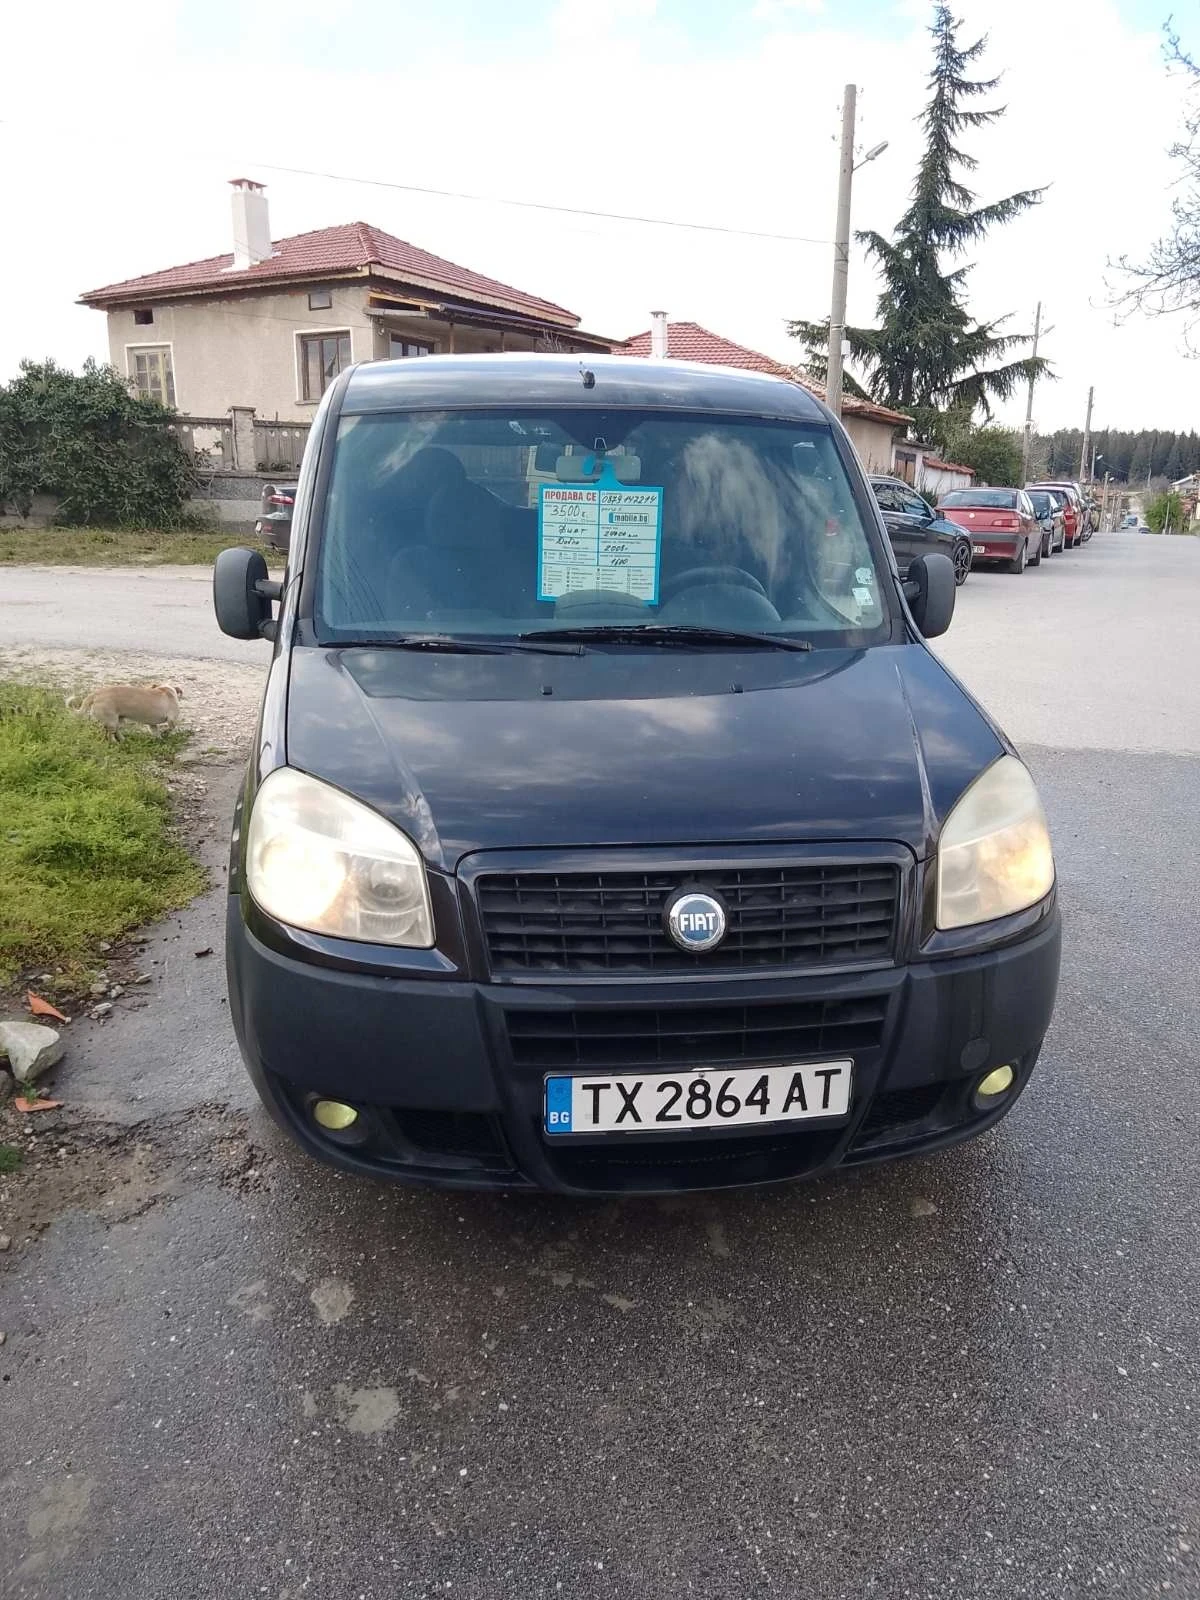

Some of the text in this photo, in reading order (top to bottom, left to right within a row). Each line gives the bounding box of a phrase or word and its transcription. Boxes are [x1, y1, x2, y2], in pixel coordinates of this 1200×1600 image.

[545, 491, 597, 502] ПРОДАВА СЕ
[551, 504, 580, 517] 3500
[614, 514, 648, 522] mobile.bg
[680, 912, 716, 932] FIAT
[655, 1074, 771, 1123] 2864
[549, 1111, 570, 1124] BG
